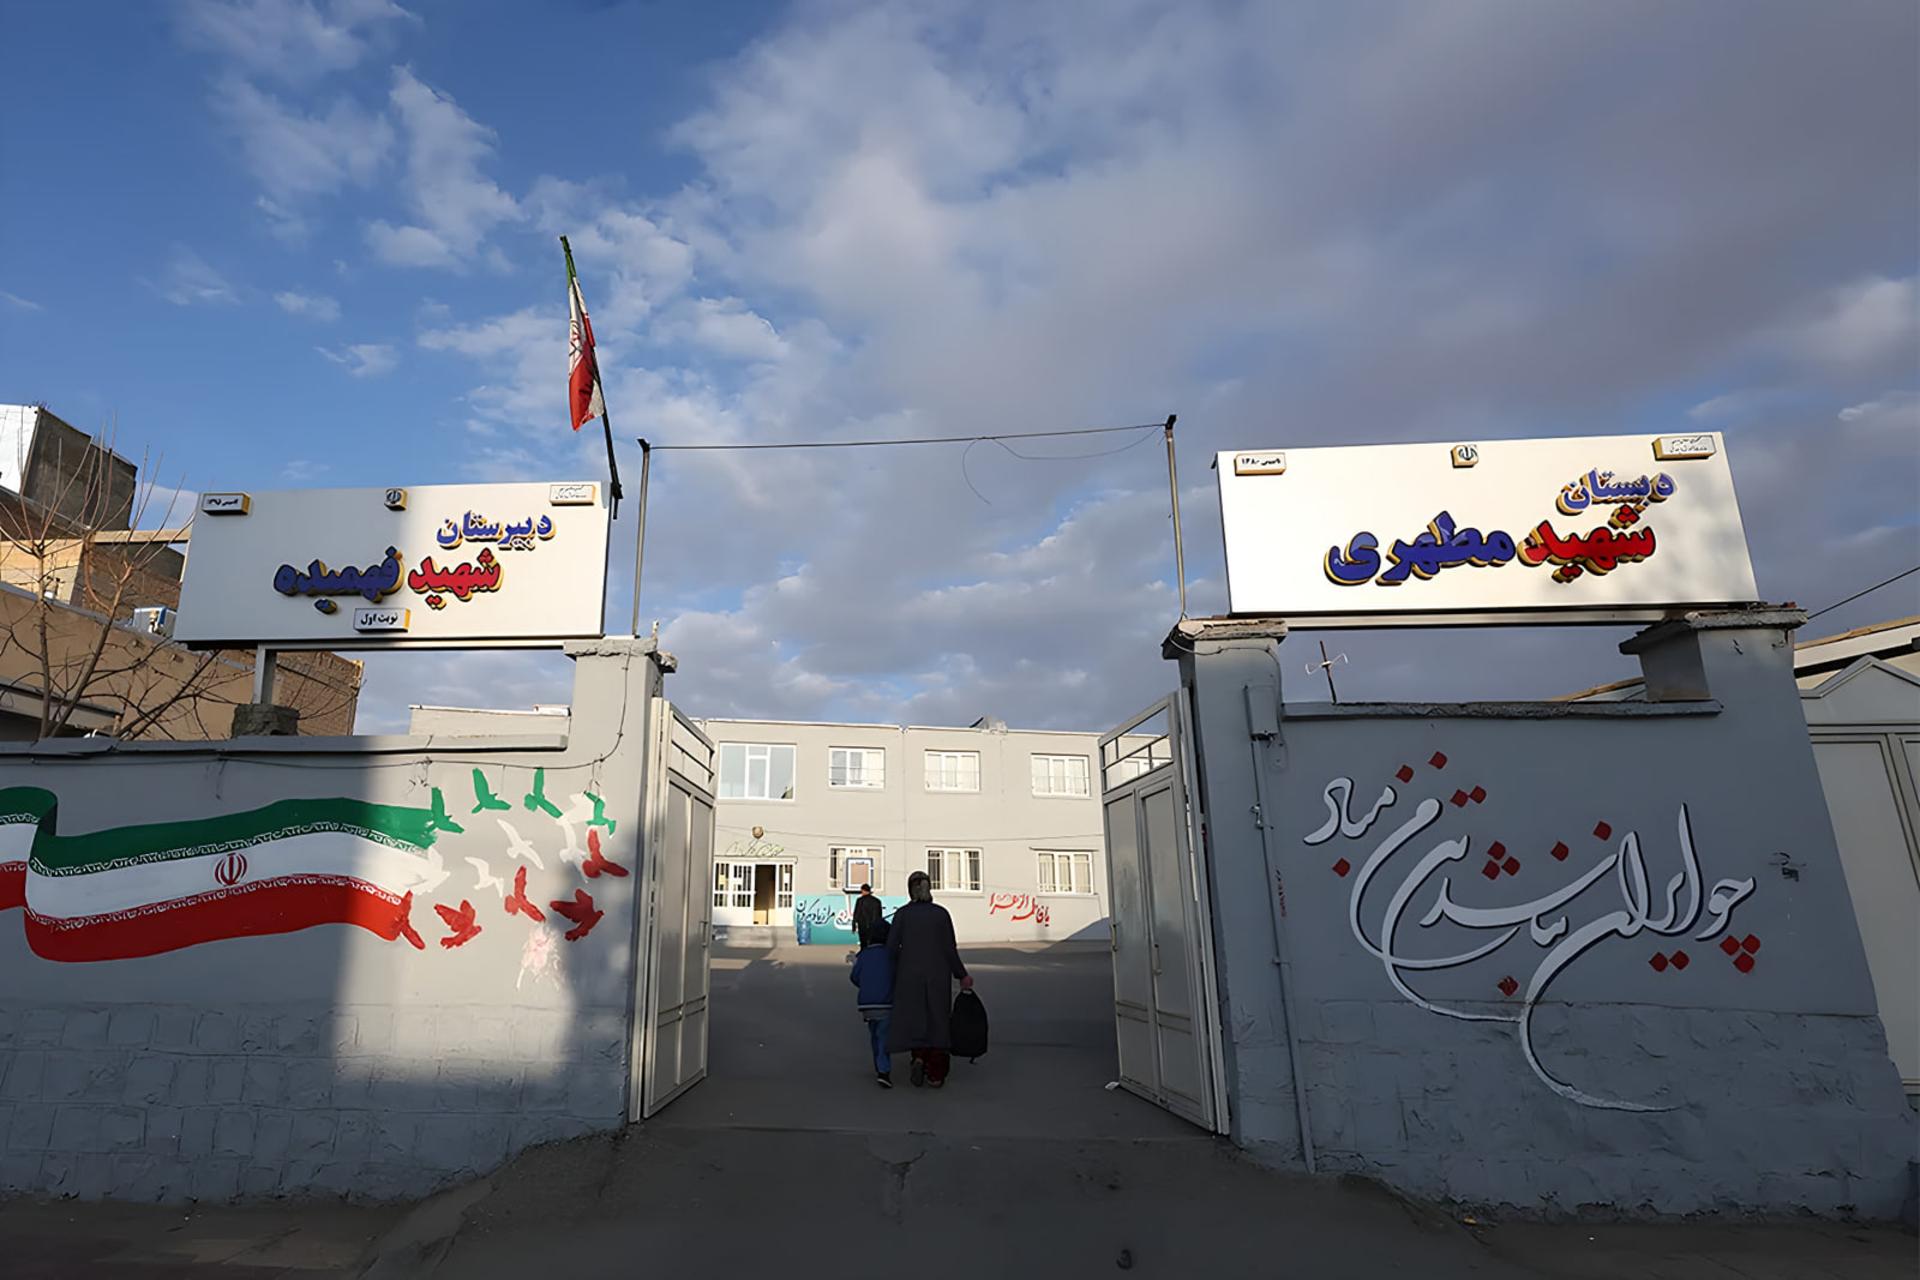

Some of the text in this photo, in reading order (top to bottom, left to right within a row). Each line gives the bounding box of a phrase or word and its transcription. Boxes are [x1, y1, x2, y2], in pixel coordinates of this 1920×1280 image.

[1556, 467, 1678, 514] دبستان
[437, 510, 556, 551] دبیرستان
[1324, 503, 1657, 587] شهید مطهری
[273, 545, 503, 615] شهید فهمیده
[360, 611, 399, 626] نوبت اول
[1303, 776, 1397, 878] مباد
[1696, 875, 1762, 975] چو
